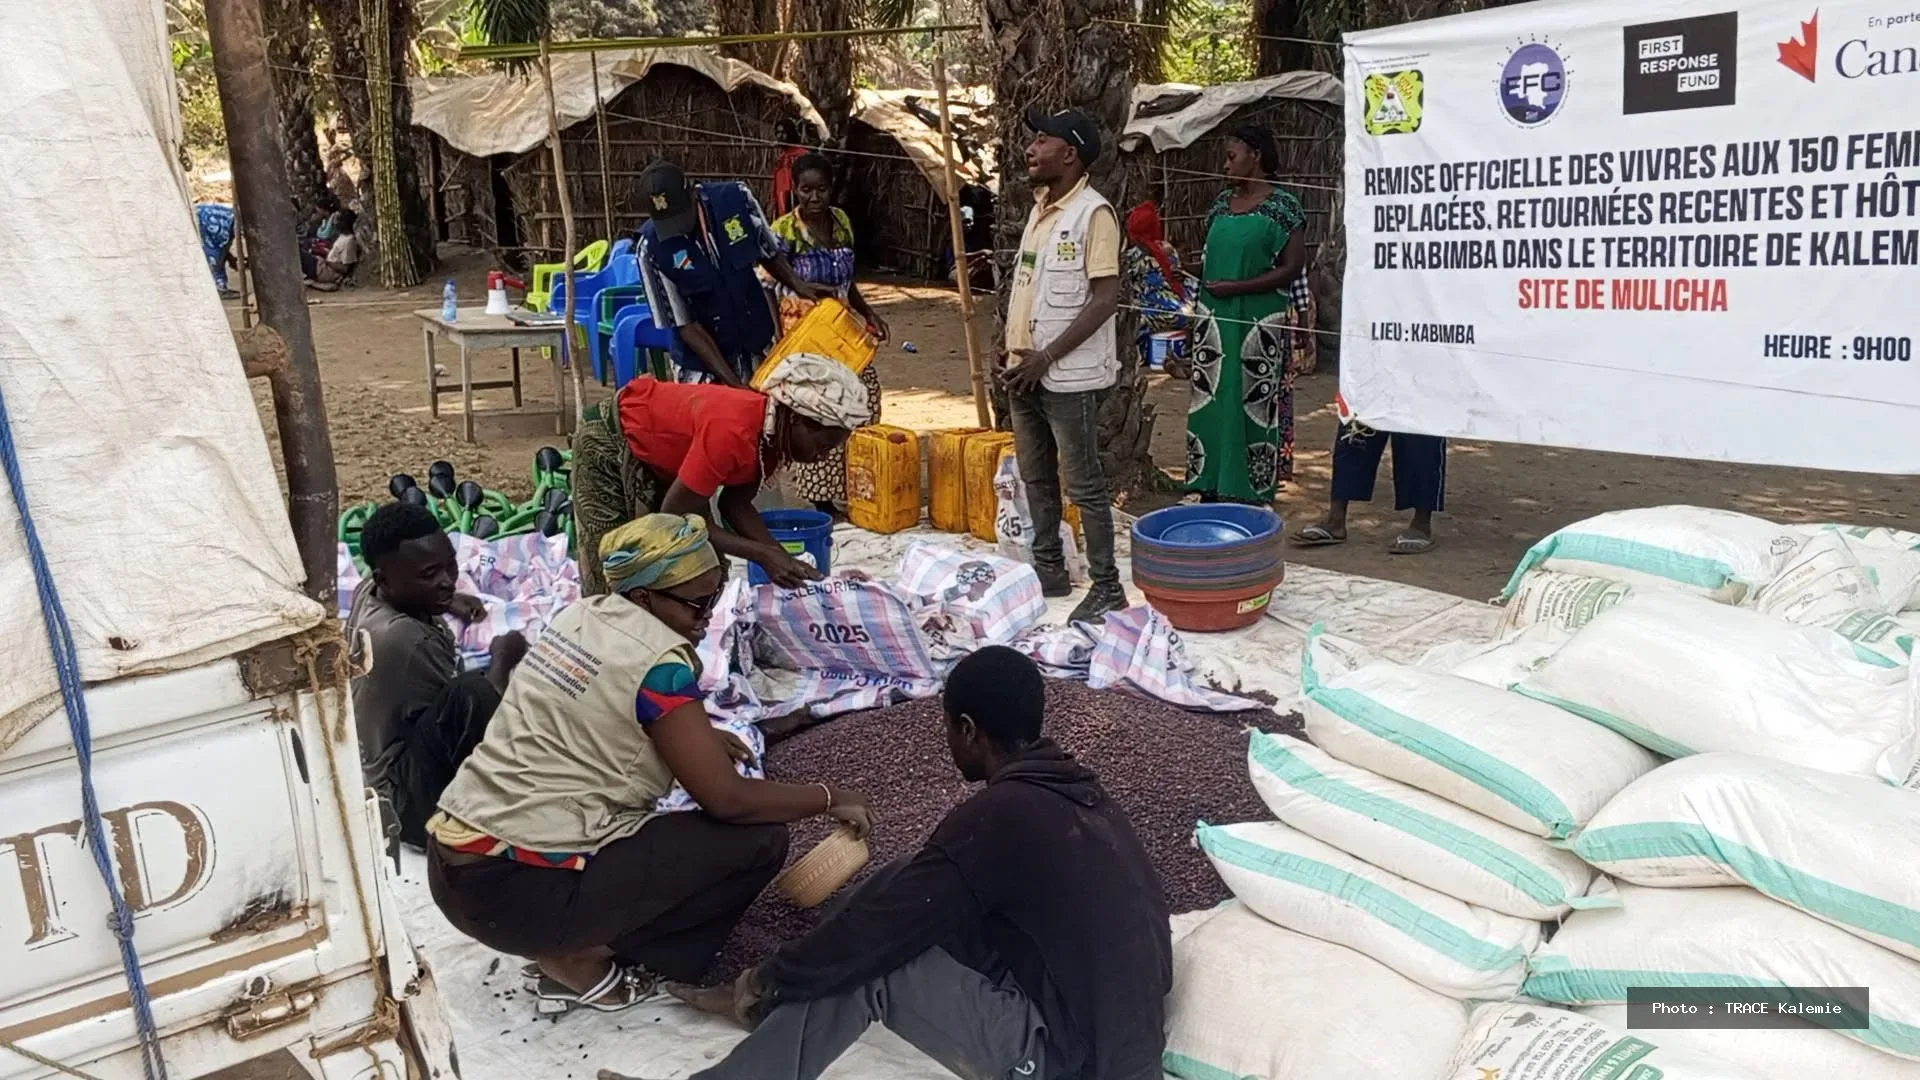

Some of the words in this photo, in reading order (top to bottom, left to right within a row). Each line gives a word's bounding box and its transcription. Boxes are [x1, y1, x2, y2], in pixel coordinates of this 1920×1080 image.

[1868, 16, 1882, 28] En
[1641, 39, 1681, 55] FIRST
[1640, 54, 1718, 74] RESPONSE
[1680, 74, 1718, 88] FUND
[1364, 163, 1436, 196] REMISE
[1440, 156, 1562, 192] OFFICIELLE
[1569, 152, 1614, 186] DES
[1620, 145, 1717, 182] VIVRES
[1723, 140, 1781, 177] AUX
[1790, 136, 1838, 173] 150
[1497, 187, 1654, 229] RETOURNÉES
[1660, 186, 1804, 225] RECENTES
[1811, 184, 1849, 219] ET
[1856, 172, 1920, 218] HÔT
[1374, 242, 1398, 269] DE
[1402, 240, 1497, 269] KABIMBA
[1503, 238, 1562, 269] DANS
[1568, 238, 1596, 269] LE
[1600, 233, 1758, 268] TERRITOIRE
[1766, 232, 1802, 266] DE
[1809, 230, 1919, 266] KALEM
[1518, 279, 1569, 309] SITE
[1575, 279, 1605, 310] DE
[1611, 279, 1729, 312] MULICHA
[1764, 334, 1831, 360] HEURE
[1853, 335, 1912, 362] 9H00
[809, 623, 870, 643] 2025
